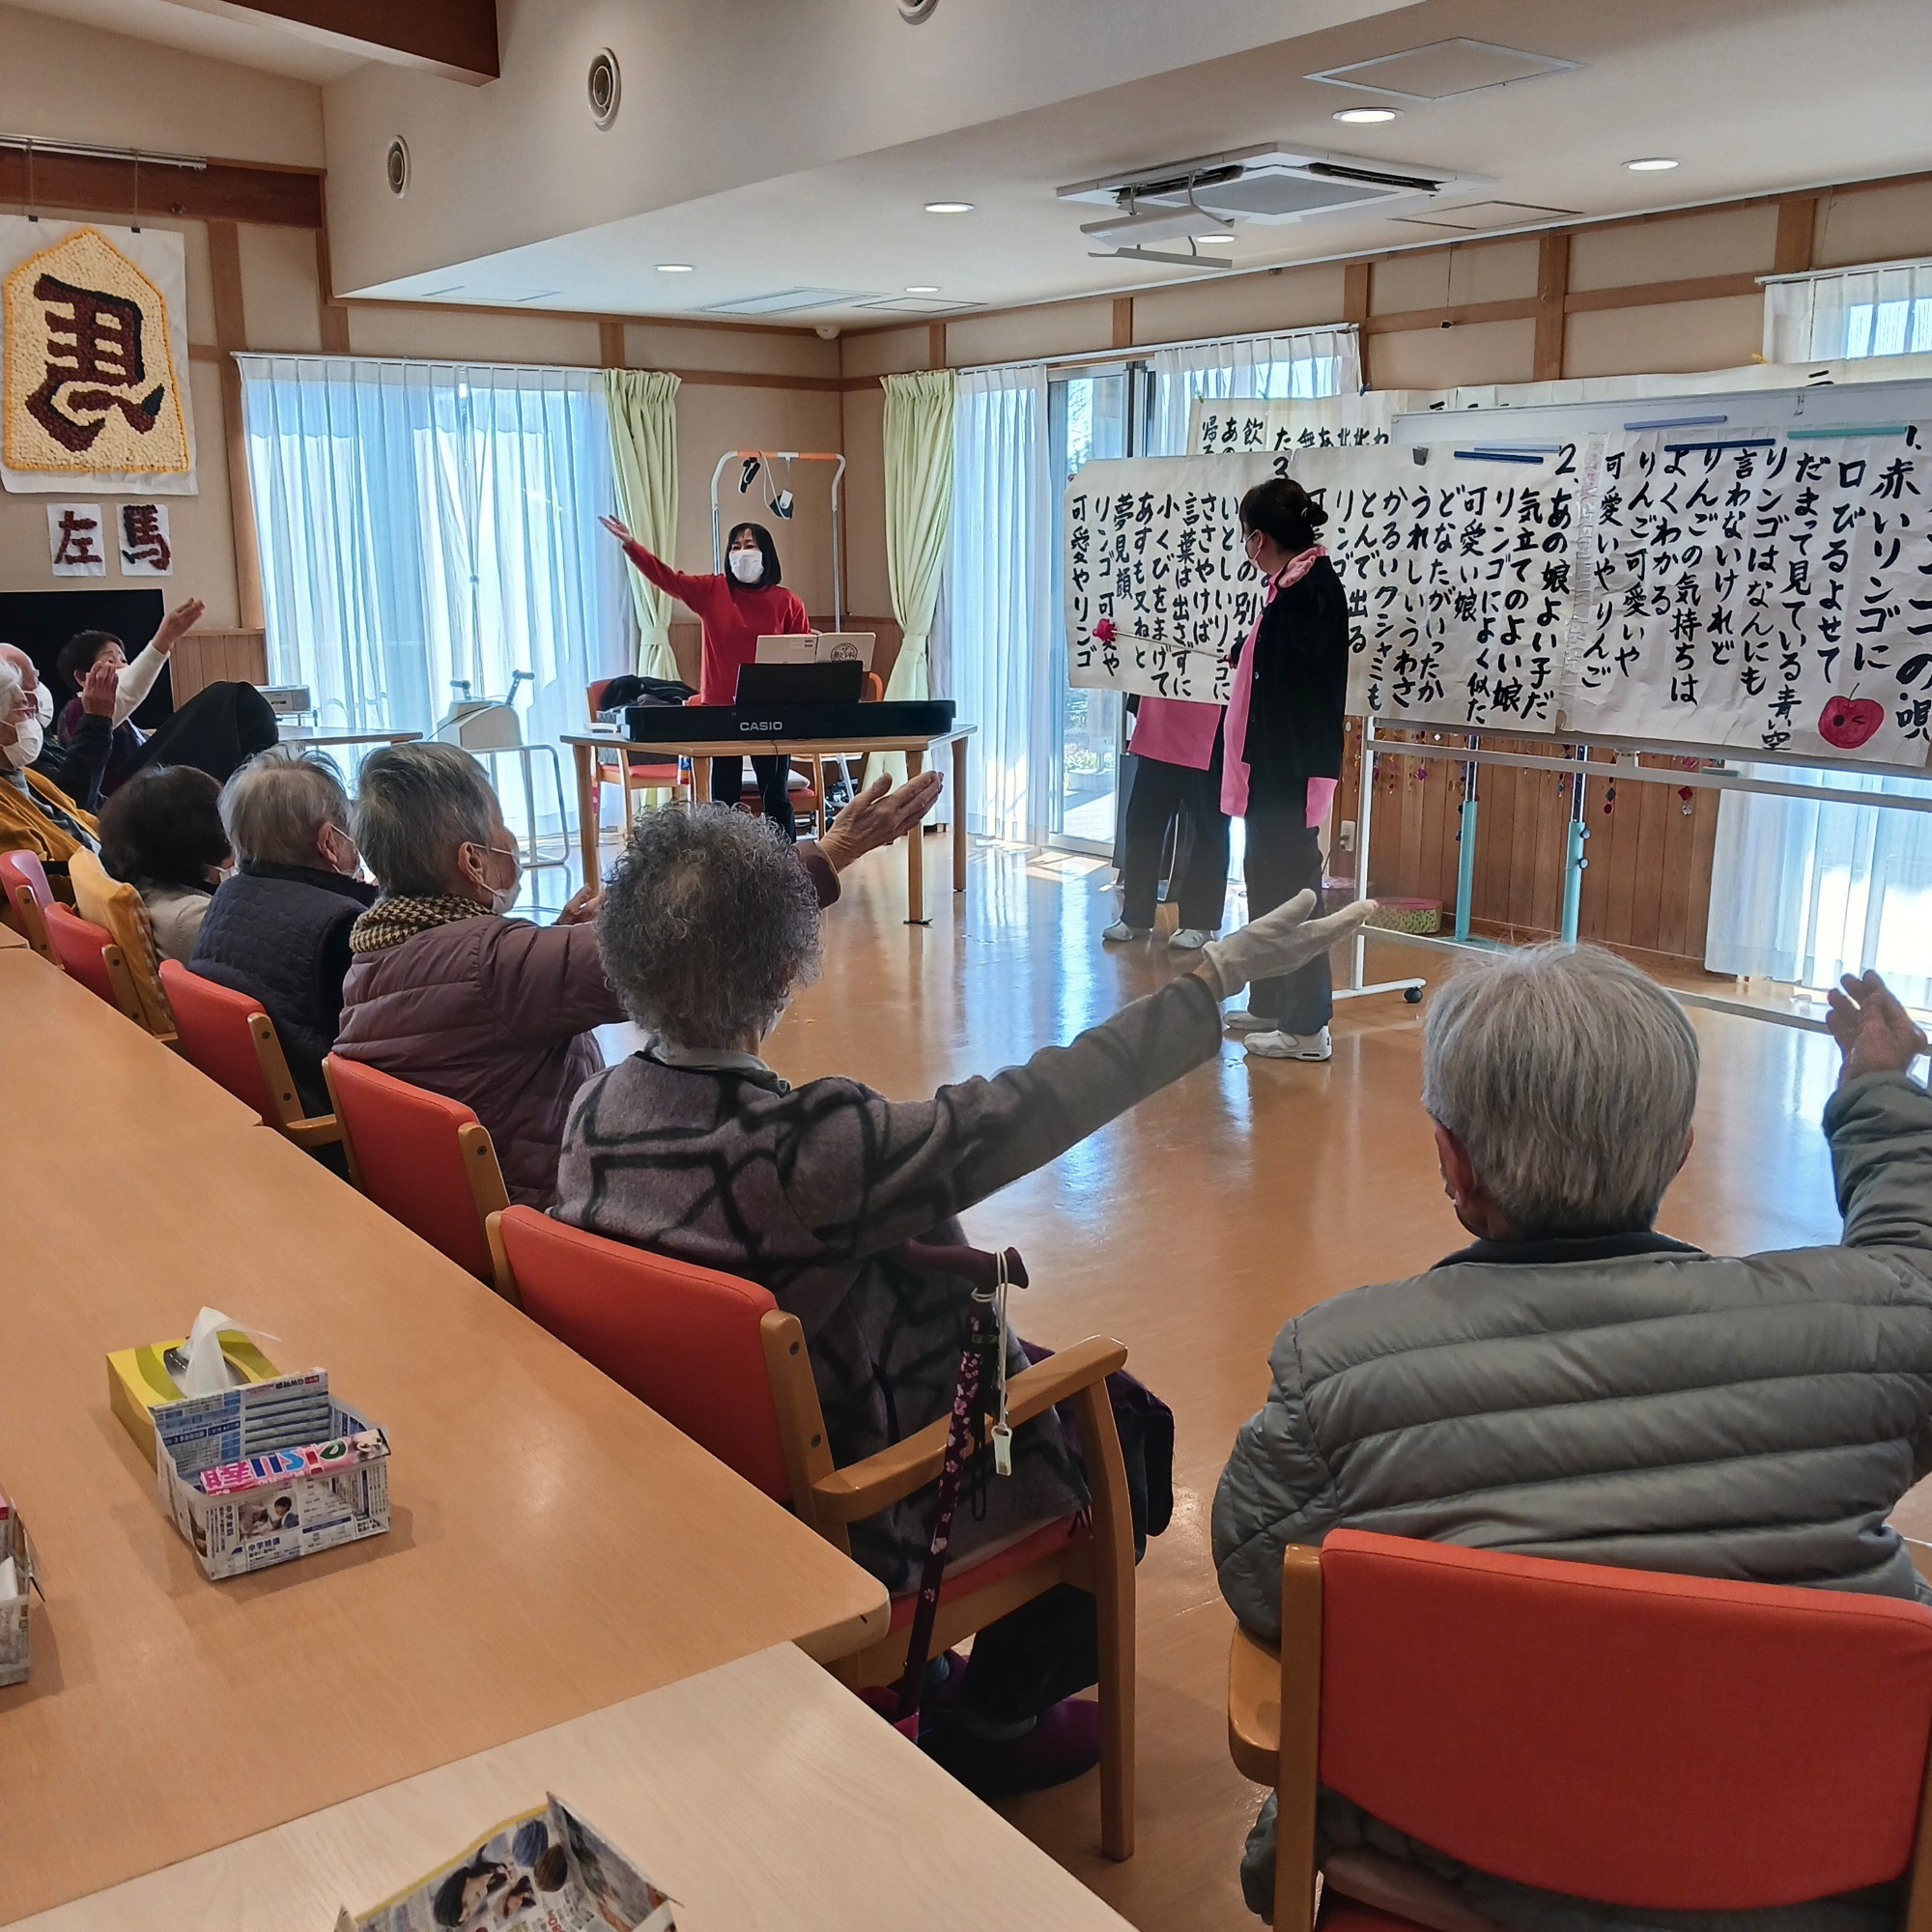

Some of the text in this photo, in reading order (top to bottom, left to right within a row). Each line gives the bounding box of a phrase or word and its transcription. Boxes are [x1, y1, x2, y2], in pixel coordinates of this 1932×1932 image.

[1242, 417, 1264, 452] 飲
[53, 510, 103, 564] 左
[121, 504, 172, 571] 馬
[1113, 493, 1134, 600] 夢見顔
[1172, 492, 1201, 696] 言葉は出さずに
[1193, 493, 1217, 645] ささやけば
[1333, 489, 1354, 583] リンゴ
[1392, 486, 1431, 708] うれしいうわさ
[1454, 487, 1488, 623] 可愛い娘
[1491, 487, 1543, 712] 気立てのよい娘
[1520, 488, 1572, 721] あの娘よい子だ
[1650, 449, 1690, 616] よくわかる
[1669, 448, 1721, 706] りんごの気持ちは
[1707, 448, 1757, 666] 言わないけれど
[1741, 446, 1789, 696] リンゴはなんにも
[1853, 458, 1921, 671] 赤いリンゴに
[739, 721, 783, 732] CASIO
